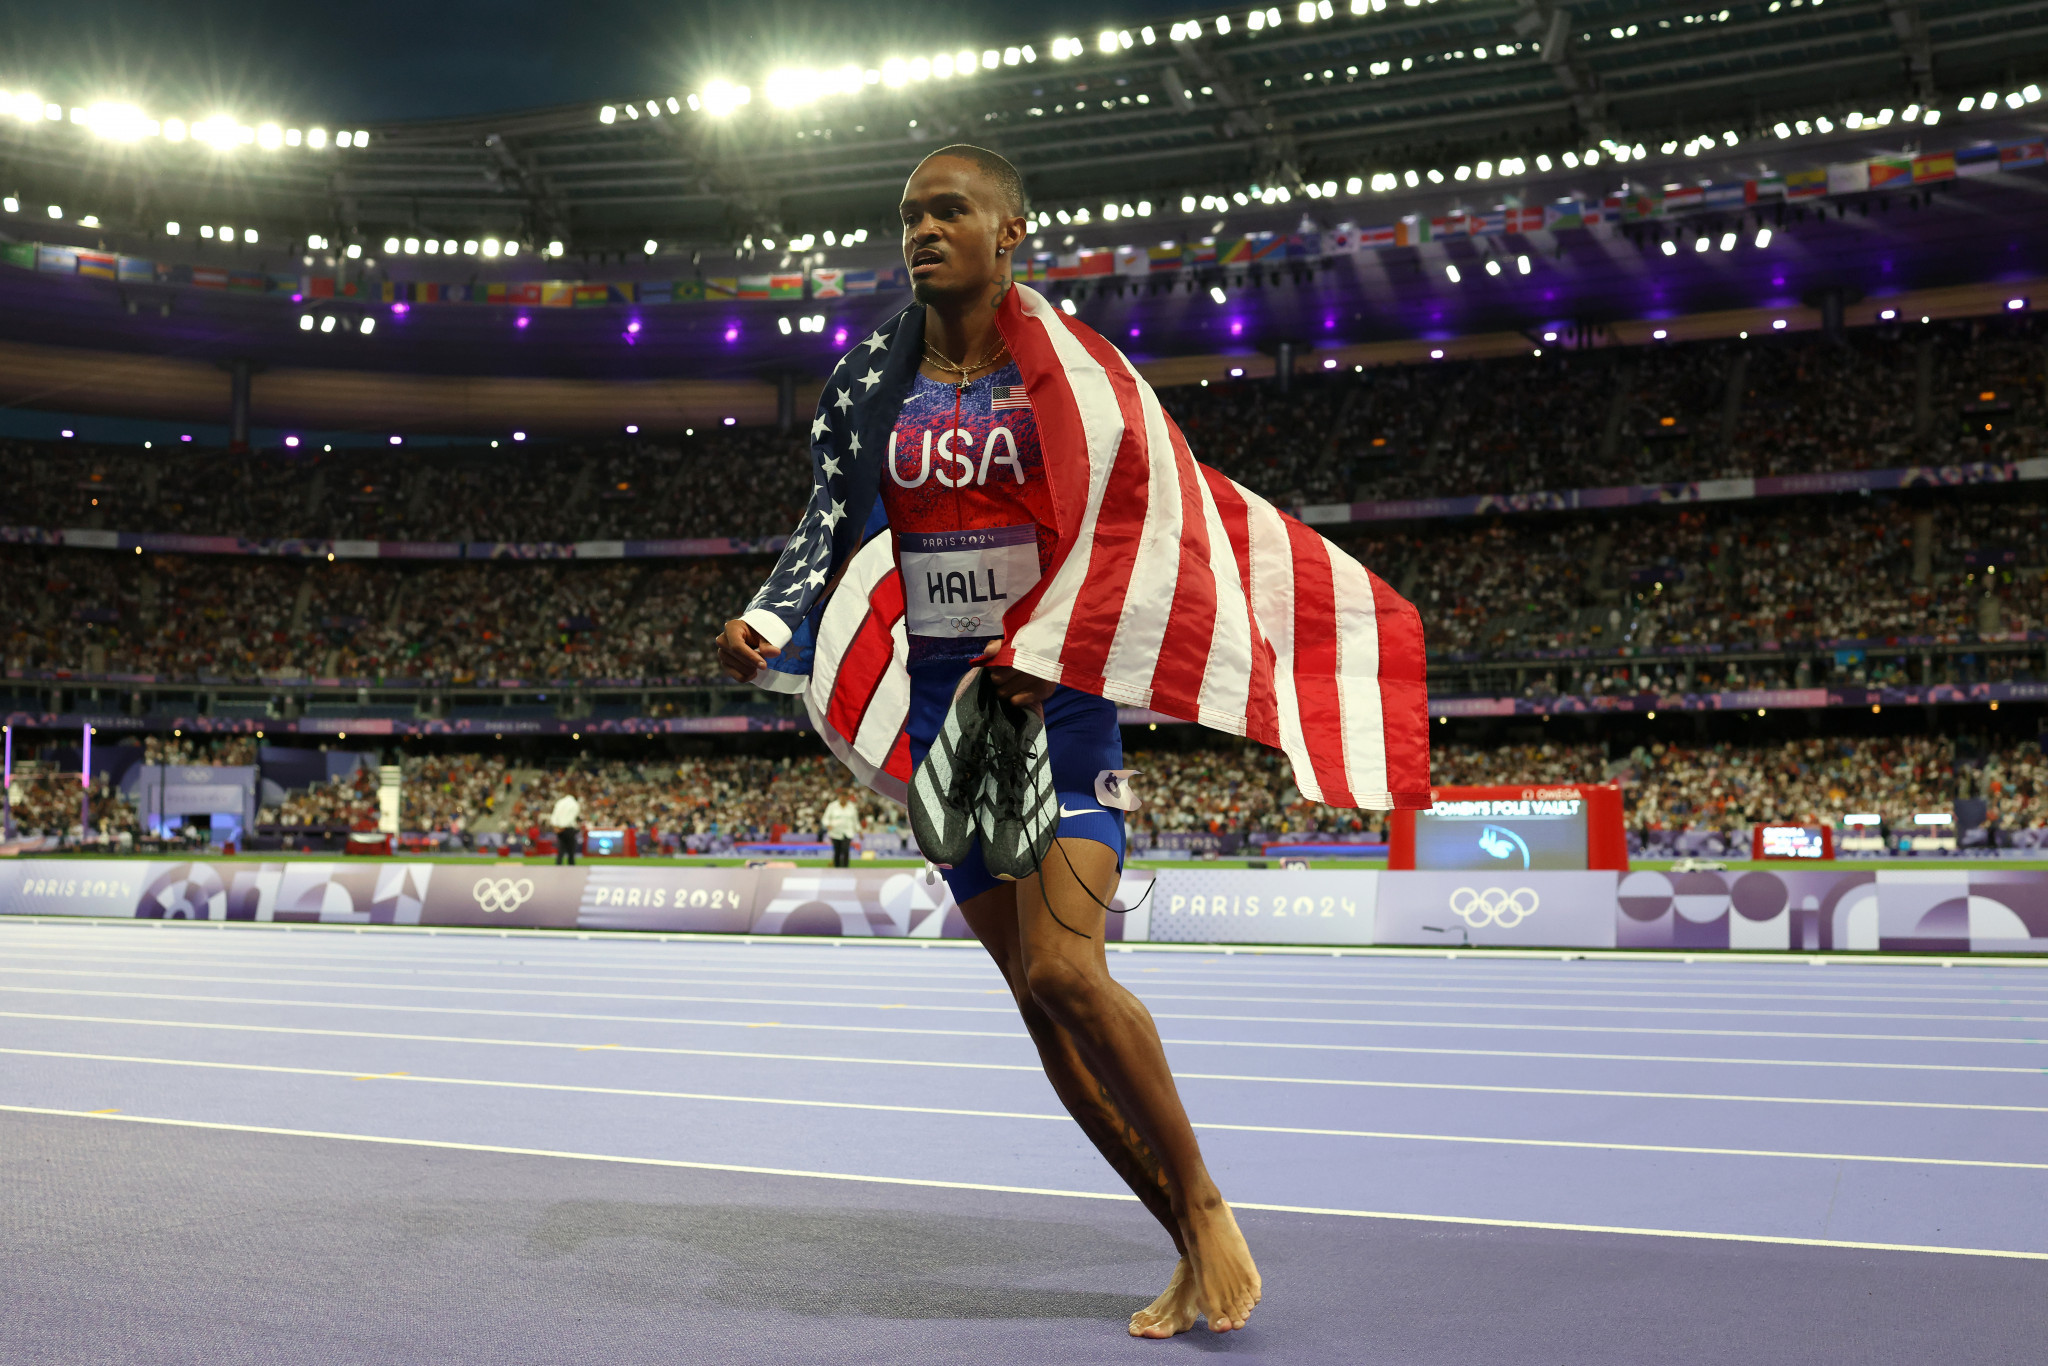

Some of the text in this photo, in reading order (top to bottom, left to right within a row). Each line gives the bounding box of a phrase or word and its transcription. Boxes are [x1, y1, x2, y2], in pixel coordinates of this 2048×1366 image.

[888, 426, 1026, 489] USA
[922, 534, 995, 547] PARIS 2024
[926, 568, 1008, 604] HALL
[1536, 787, 1582, 801] OMEGA
[1492, 800, 1531, 816] POLE
[1531, 800, 1580, 815] VAULT
[22, 878, 130, 898] PARIS 2024
[595, 887, 740, 909] PARIS 2024
[1170, 894, 1356, 917] PARIS 2024
